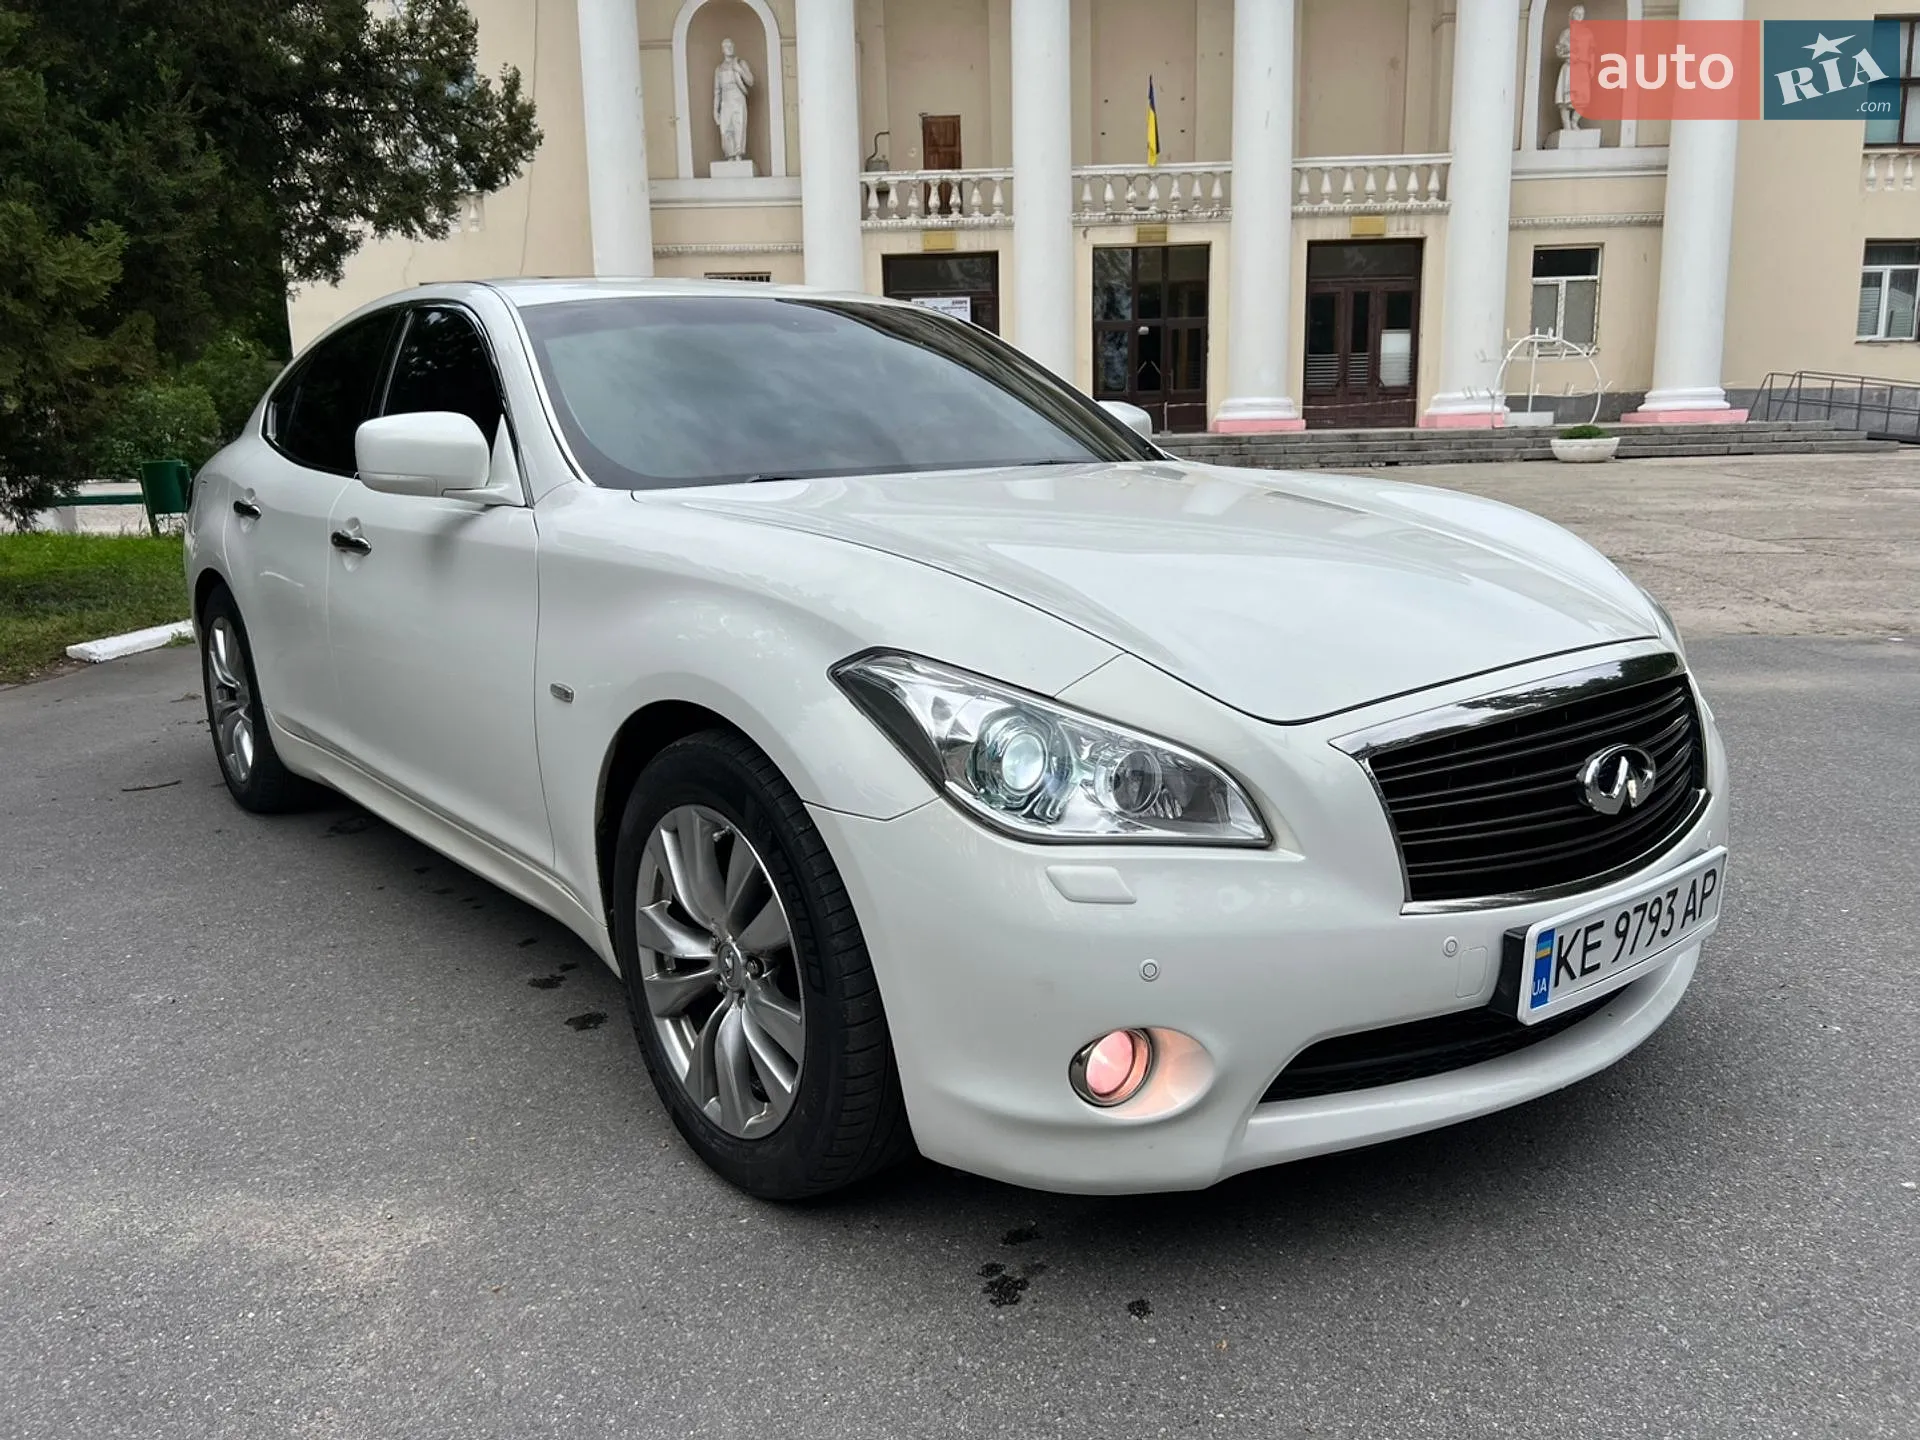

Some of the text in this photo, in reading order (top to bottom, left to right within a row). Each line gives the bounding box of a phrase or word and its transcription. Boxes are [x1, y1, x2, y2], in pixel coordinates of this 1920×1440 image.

[1554, 868, 1718, 988] KE 9793 AP
[1532, 977, 1547, 996] UA
